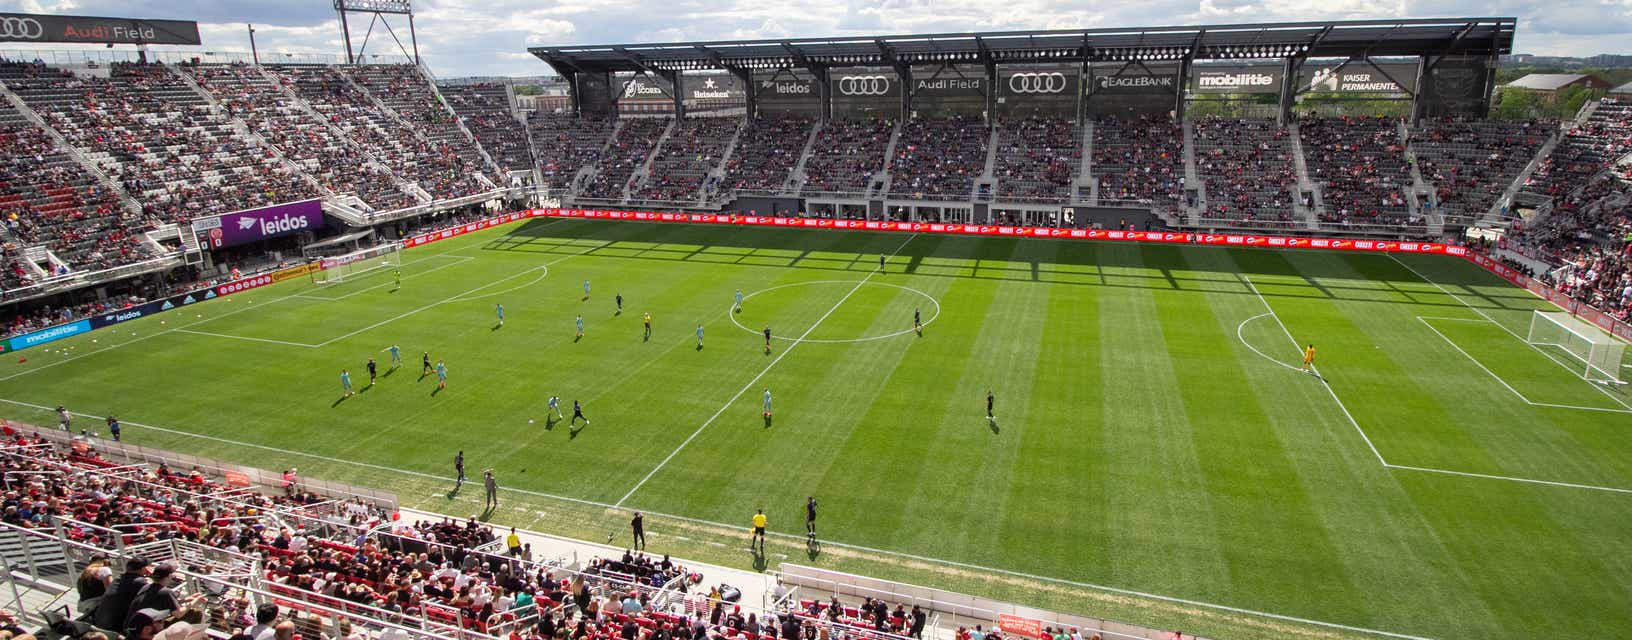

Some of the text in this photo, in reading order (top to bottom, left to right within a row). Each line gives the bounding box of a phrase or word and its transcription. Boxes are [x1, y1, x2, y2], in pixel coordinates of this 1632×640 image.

[64, 25, 156, 39] Audi Field
[1199, 74, 1273, 86] mobilitie
[1343, 74, 1370, 82] KAISER
[776, 82, 810, 93] leidos
[918, 80, 980, 89] Audi Field
[694, 90, 729, 98] Heineken
[260, 213, 308, 236] leidos
[116, 310, 142, 322] leidos
[26, 325, 78, 343] mobilitie
